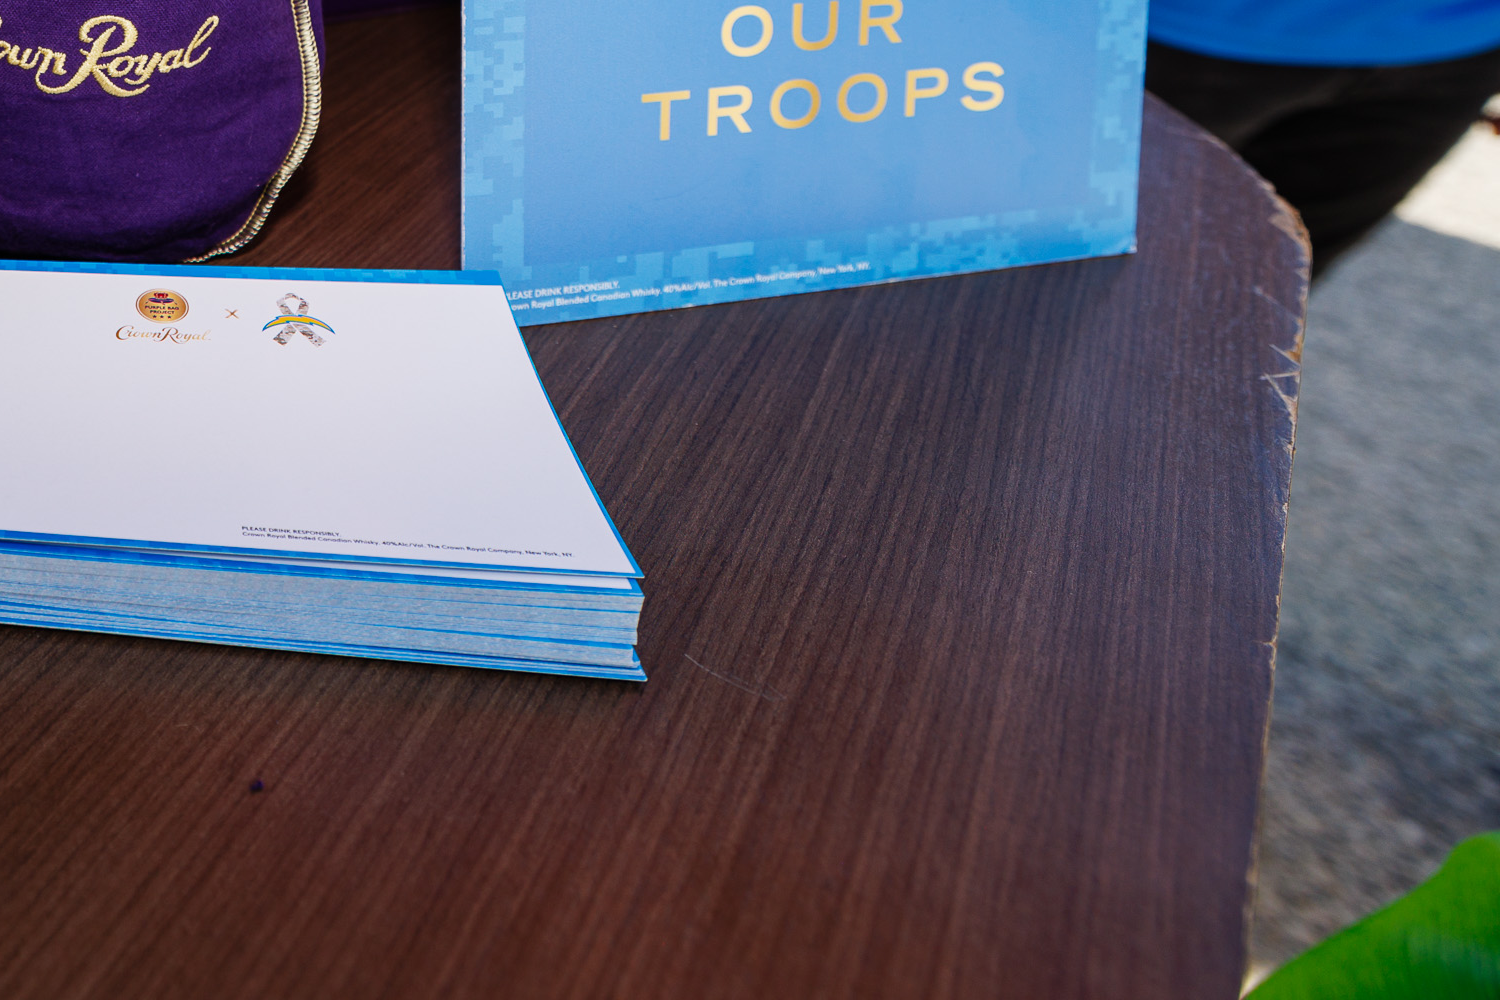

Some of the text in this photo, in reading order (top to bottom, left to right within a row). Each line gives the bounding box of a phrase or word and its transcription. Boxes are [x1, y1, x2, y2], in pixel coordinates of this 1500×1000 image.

[35, 14, 220, 98] Royal
[641, 62, 1006, 142] TROOPS
[511, 303, 530, 311] own
[531, 300, 554, 310] Royal
[556, 295, 590, 306] Blended
[591, 291, 630, 303] Canadian
[713, 278, 728, 287] The
[729, 276, 755, 286] Crown
[756, 273, 779, 283] Royal
[818, 267, 836, 275] New
[534, 287, 562, 298] DRINK
[116, 325, 210, 344] Crown Royal
